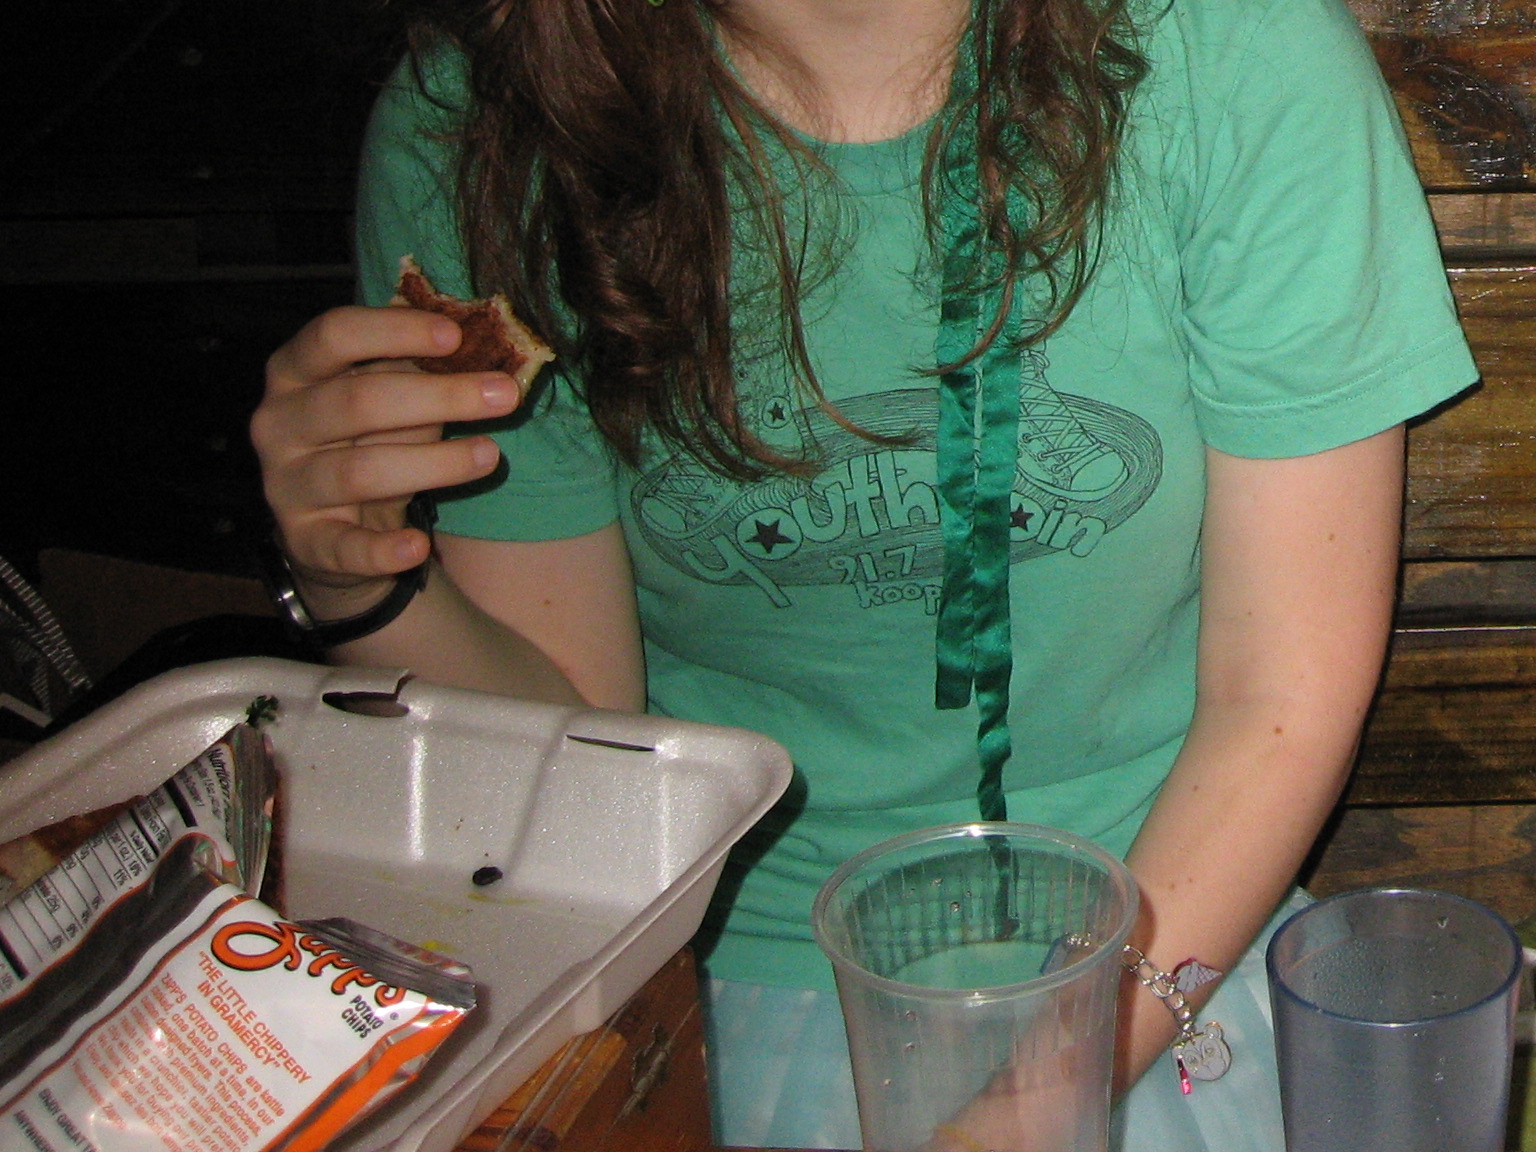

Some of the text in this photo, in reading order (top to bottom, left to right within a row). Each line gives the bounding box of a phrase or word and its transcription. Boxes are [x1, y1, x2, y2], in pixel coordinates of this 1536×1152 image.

[828, 544, 918, 585] 91.7
[197, 979, 215, 997] IN
[340, 1007, 371, 1039] CHIPS
[350, 994, 383, 1030] POTATO
[156, 1016, 191, 1055] designed
[187, 1053, 214, 1082] fryers.
[213, 1080, 233, 1101] This
[184, 1003, 219, 1042] POTATO
[217, 1041, 247, 1074] CHIPS
[245, 1074, 262, 1092] are
[260, 1089, 286, 1117] kettle
[216, 979, 257, 1023] LITTLE
[251, 1019, 311, 1086] CHIPPERY
[118, 1066, 136, 1085] you
[135, 1082, 149, 1096] for
[145, 1094, 174, 1126] buying
[173, 1124, 188, 1140] our
[150, 1053, 191, 1099] crunchier,
[188, 1096, 216, 1126] tastier
[151, 1076, 174, 1101] hope
[172, 1101, 188, 1119] you
[188, 1117, 204, 1134] will
[171, 1056, 208, 1097] premium
[204, 1093, 252, 1146] ingredients,
[172, 1013, 189, 1031] one
[187, 1029, 213, 1057] batch
[209, 1056, 222, 1068] at
[226, 1075, 249, 1100] time,
[257, 1108, 274, 1126] our
[55, 1111, 86, 1146] GREAT
